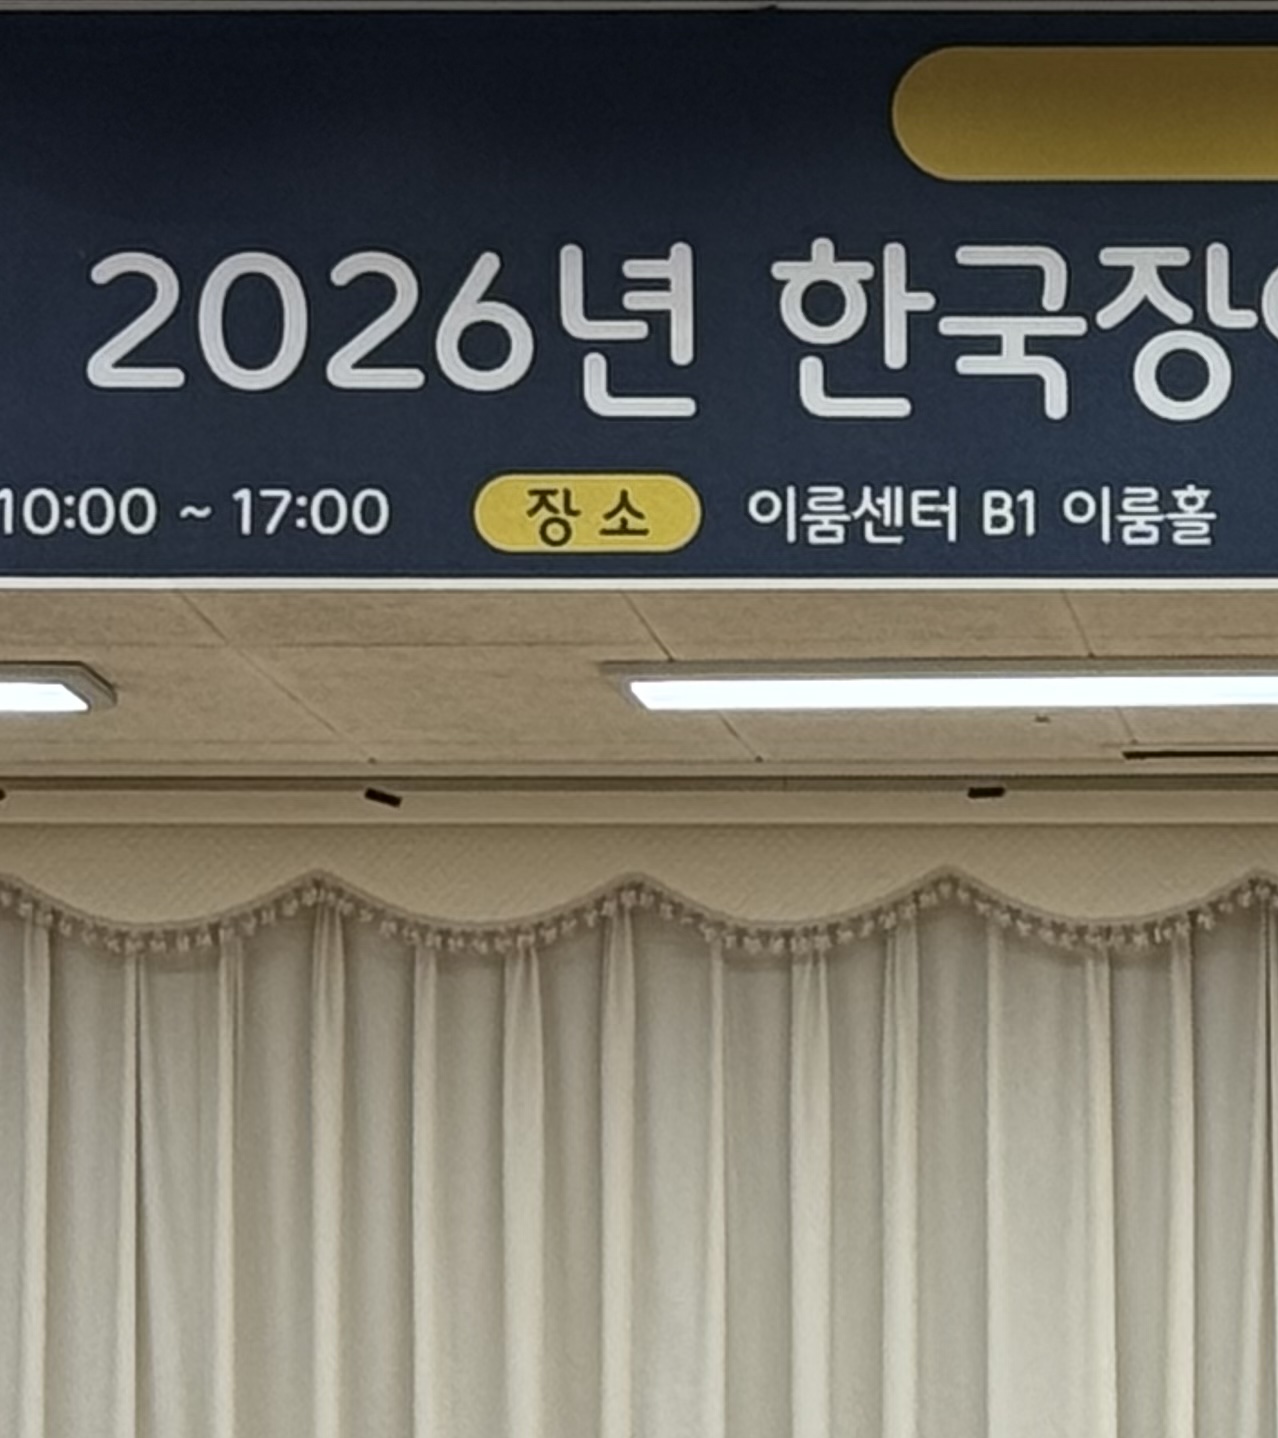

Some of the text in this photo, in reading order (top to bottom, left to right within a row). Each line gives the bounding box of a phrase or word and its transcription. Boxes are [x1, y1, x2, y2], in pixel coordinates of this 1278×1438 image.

[87, 243, 696, 416] 2026년
[0, 488, 156, 534] 10:00
[233, 488, 389, 535] 17:00
[748, 485, 1216, 545] 이룸센터 B1 이룸홀
